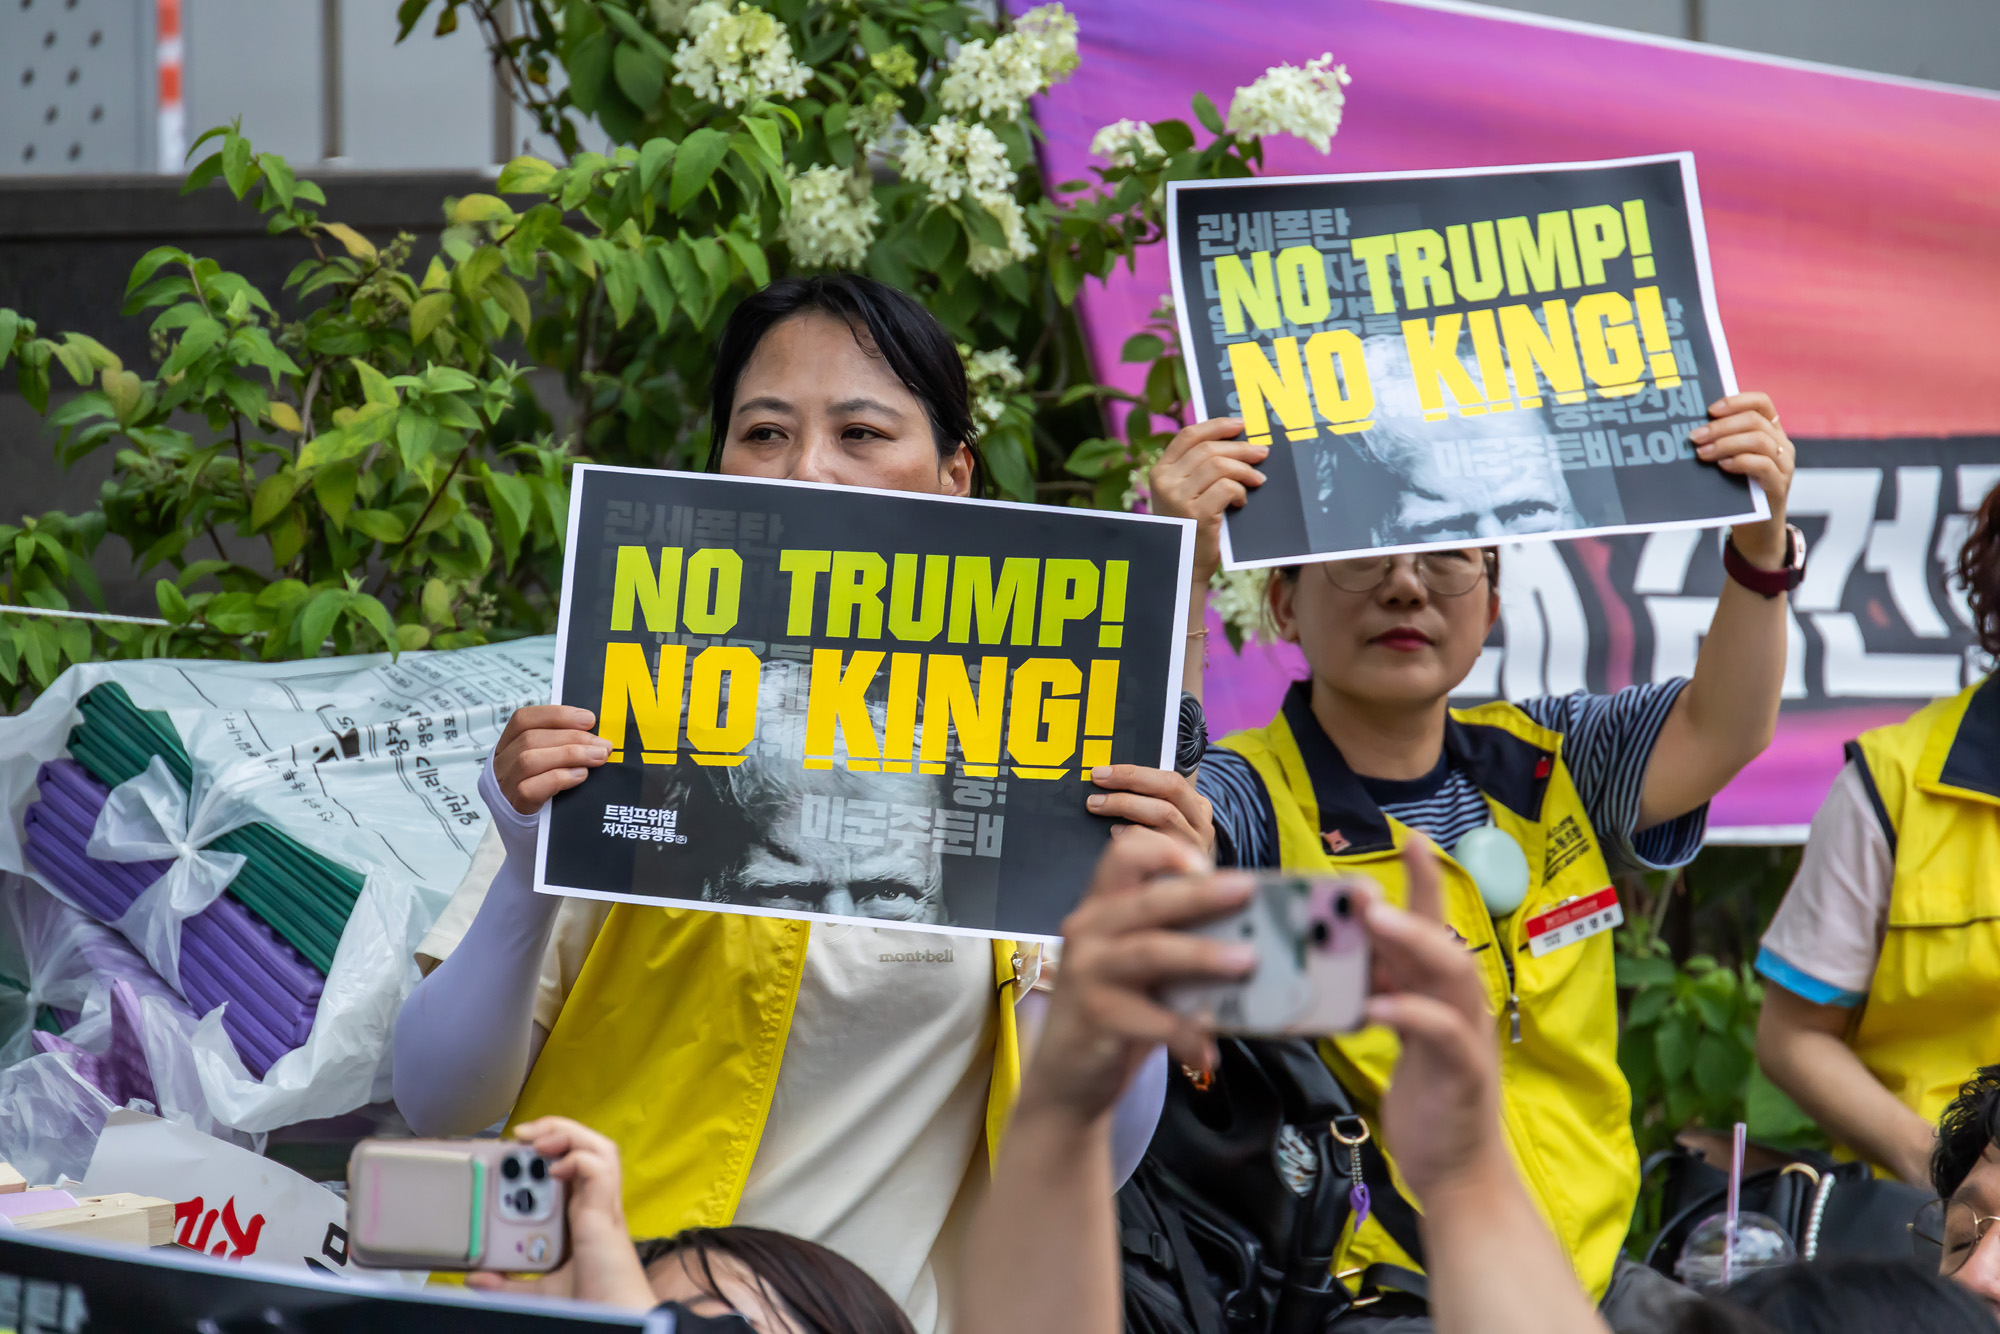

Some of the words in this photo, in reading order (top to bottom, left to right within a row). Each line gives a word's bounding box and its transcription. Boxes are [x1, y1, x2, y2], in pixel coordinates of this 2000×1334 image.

[1197, 207, 1352, 256] 관세폭탄
[1214, 245, 1332, 334] NO
[1351, 200, 1655, 314] TRUMP!
[1227, 329, 1376, 446] NO
[1401, 285, 1682, 423] KING!
[610, 545, 744, 635] NO
[779, 549, 1131, 648] TRUMP!
[597, 642, 763, 767] NO
[803, 648, 1121, 782] KING!
[603, 804, 678, 828] 트럼프위협
